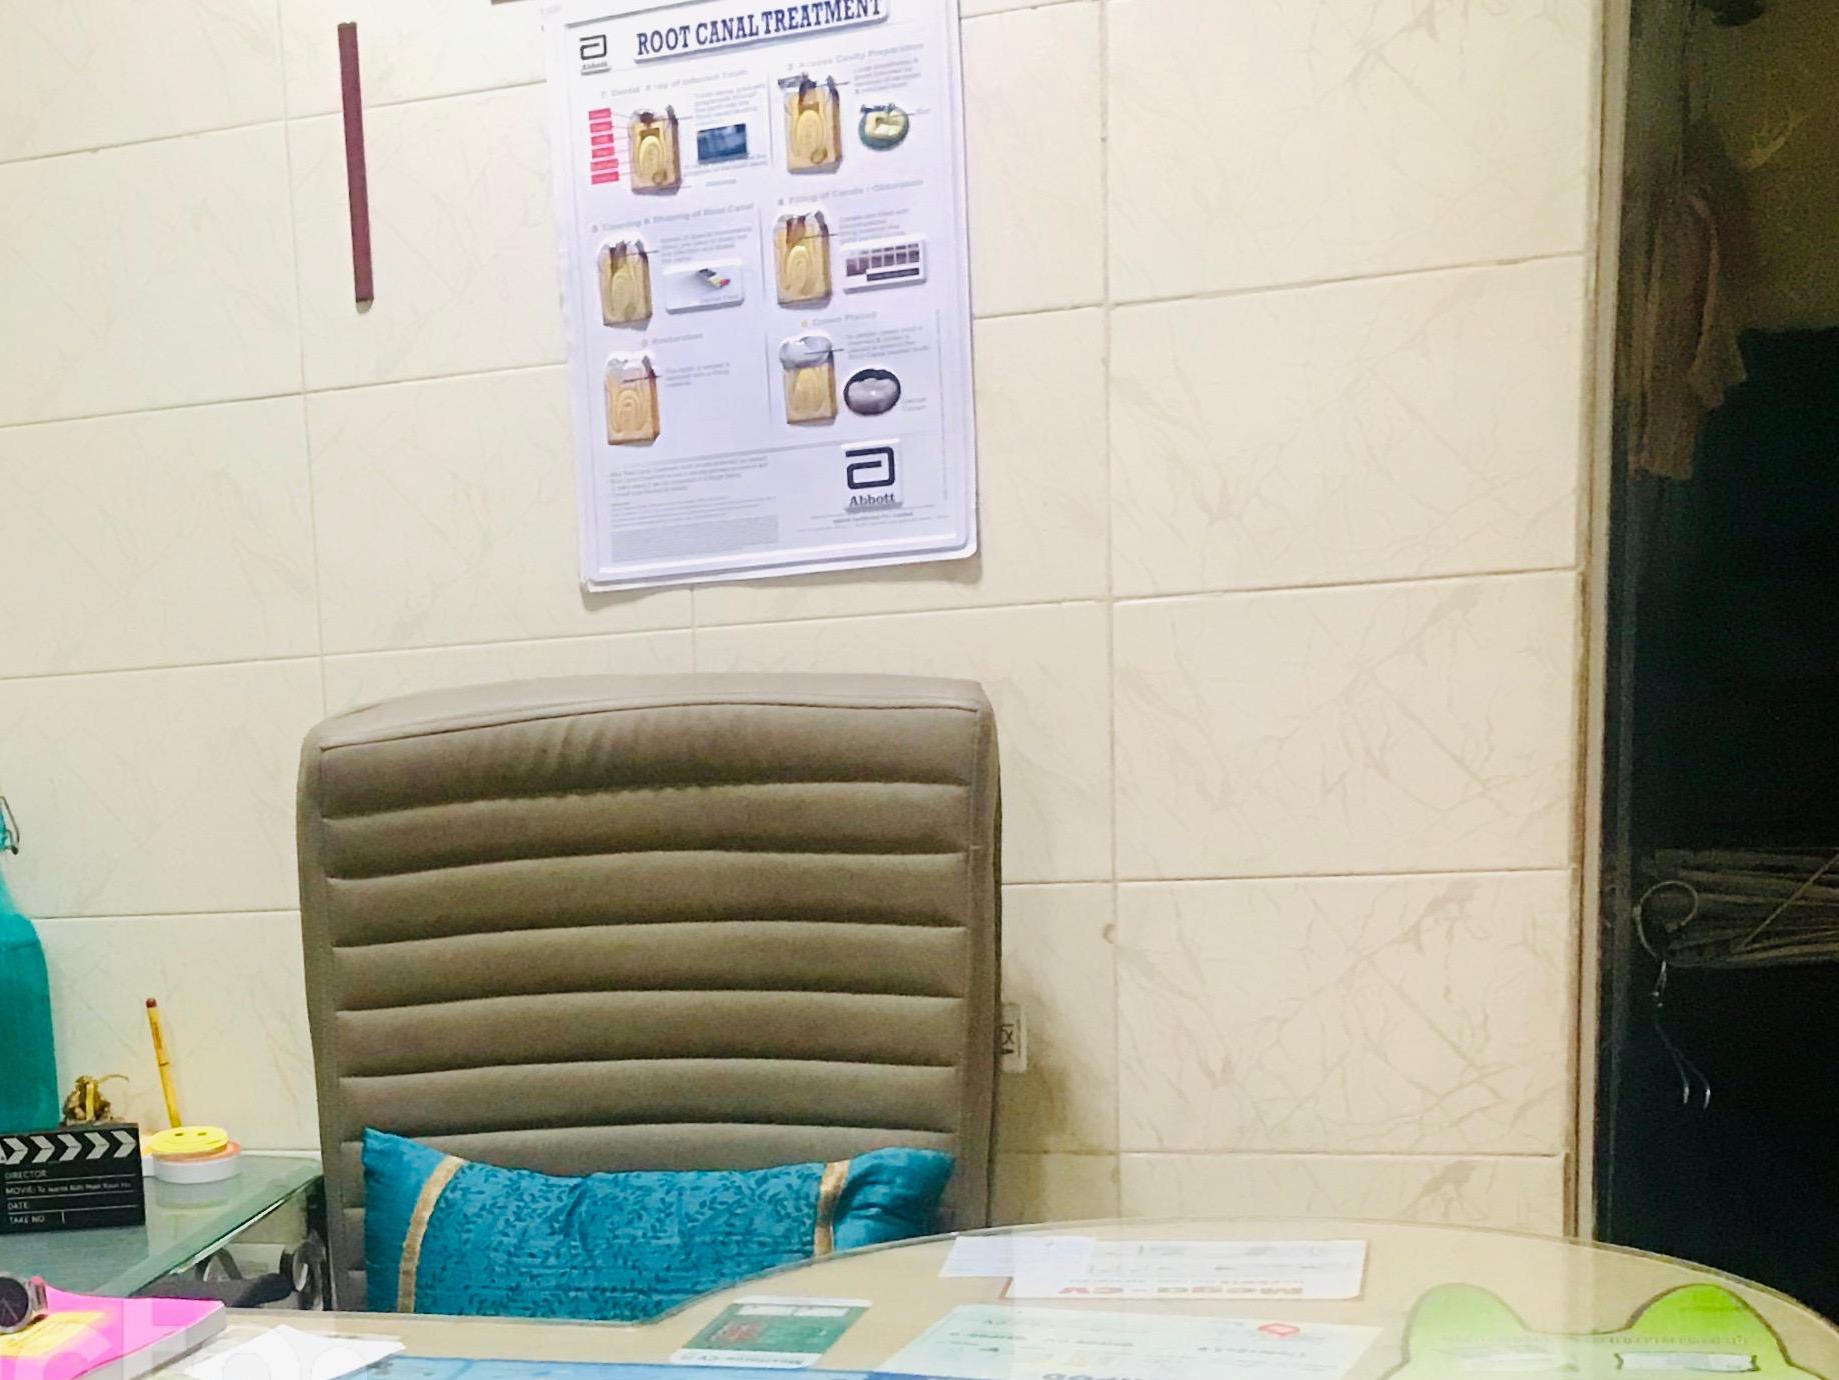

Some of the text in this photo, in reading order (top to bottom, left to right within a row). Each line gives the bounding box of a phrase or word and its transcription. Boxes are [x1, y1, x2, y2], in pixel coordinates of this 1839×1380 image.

[636, 0, 881, 56] ROOT CANAL TREATMENT
[848, 492, 896, 507] Abbott
